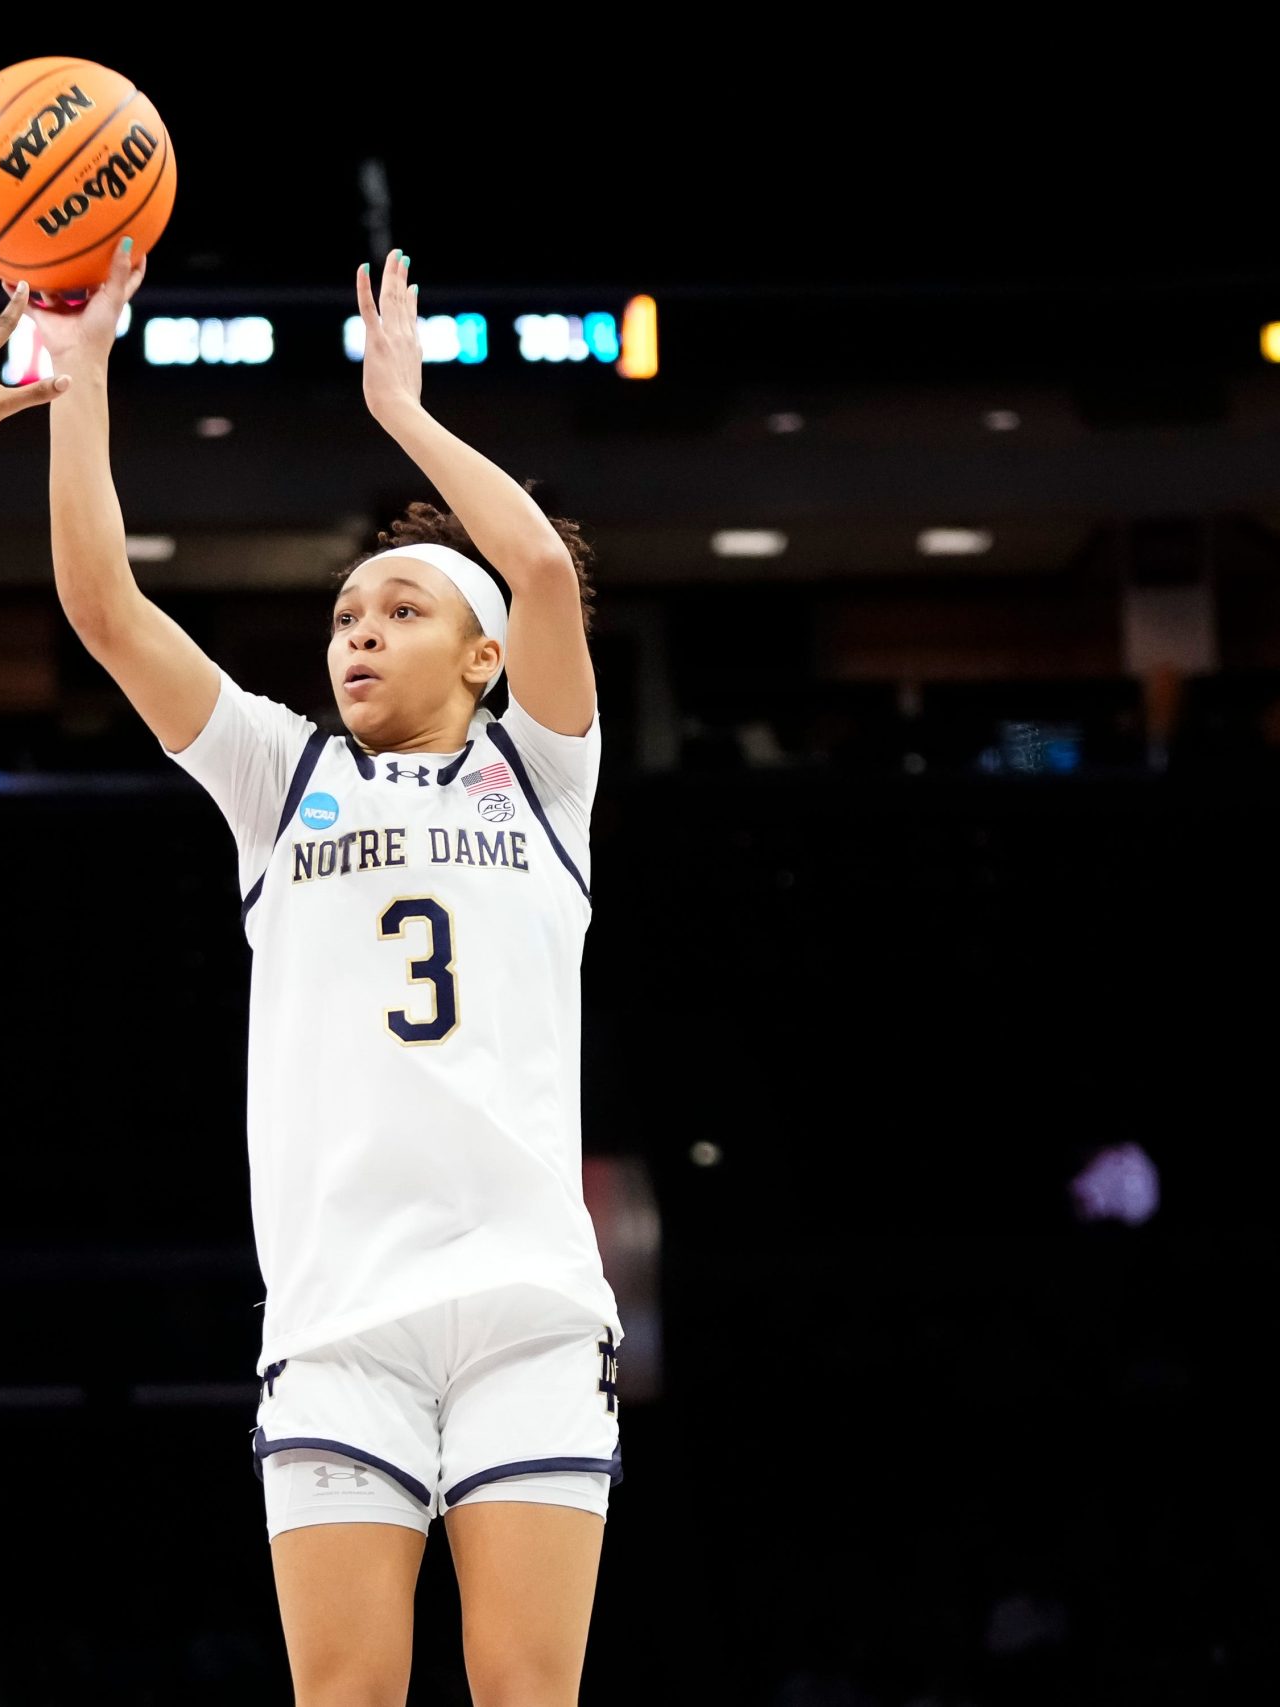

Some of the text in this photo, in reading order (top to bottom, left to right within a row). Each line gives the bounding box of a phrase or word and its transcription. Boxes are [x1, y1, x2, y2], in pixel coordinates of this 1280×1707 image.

[36, 123, 159, 236] Wilson
[304, 807, 337, 822] NCAA
[483, 802, 512, 812] ACC
[292, 826, 530, 884] NOTRE DAME
[377, 895, 461, 1047] 3
